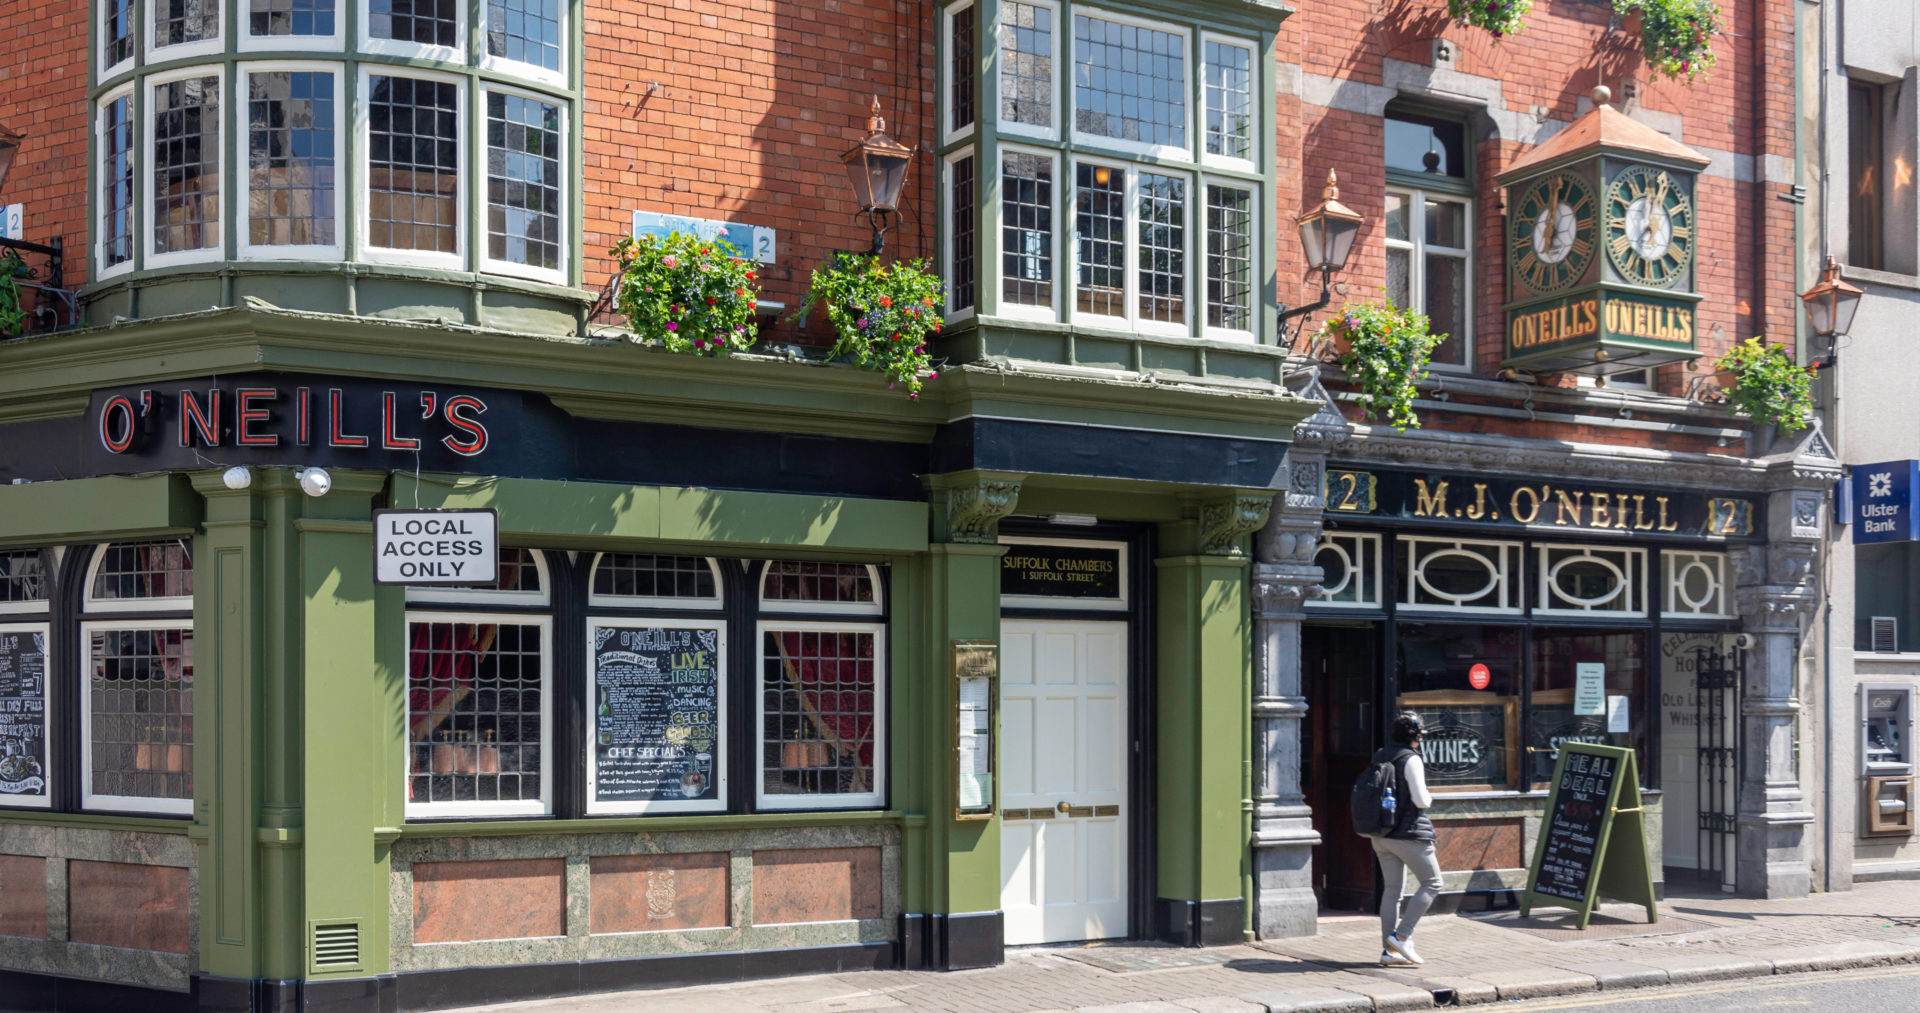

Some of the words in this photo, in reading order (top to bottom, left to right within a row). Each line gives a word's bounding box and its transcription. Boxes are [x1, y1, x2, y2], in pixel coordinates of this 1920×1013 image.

[11, 213, 19, 231] 2
[758, 235, 770, 253] 2
[1511, 299, 1598, 350] O'NEILL'S
[1604, 297, 1693, 343] O'NEILL'S
[99, 386, 489, 457] O'NEILL'S
[1338, 472, 1360, 510] 2
[1509, 484, 1679, 533] O'NEILL
[1721, 500, 1738, 533] 2
[1861, 503, 1900, 518] Ulster
[391, 519, 474, 536] LOCAL
[1864, 518, 1897, 534] Bank
[382, 540, 484, 557] ACCESS
[400, 561, 466, 578] ONLY
[1003, 556, 1050, 570] SUFFOLK
[1055, 558, 1113, 573] CHAMBERS
[1029, 571, 1063, 581] SUFFOLK
[1066, 572, 1095, 583] STREET
[620, 631, 691, 647] O'NEILL'S
[671, 650, 710, 670] LIVE
[33, 672, 43, 695] 7
[671, 669, 709, 684] IRISH
[673, 698, 712, 707] DANCING
[672, 710, 710, 725] BEER
[665, 724, 716, 741] GARDEN
[607, 746, 635, 759] CHEF
[636, 746, 686, 759] SPECIAL'S
[1419, 740, 1480, 764] WINES
[1565, 753, 1612, 778] MEAL
[1560, 772, 1607, 796] DEAL
